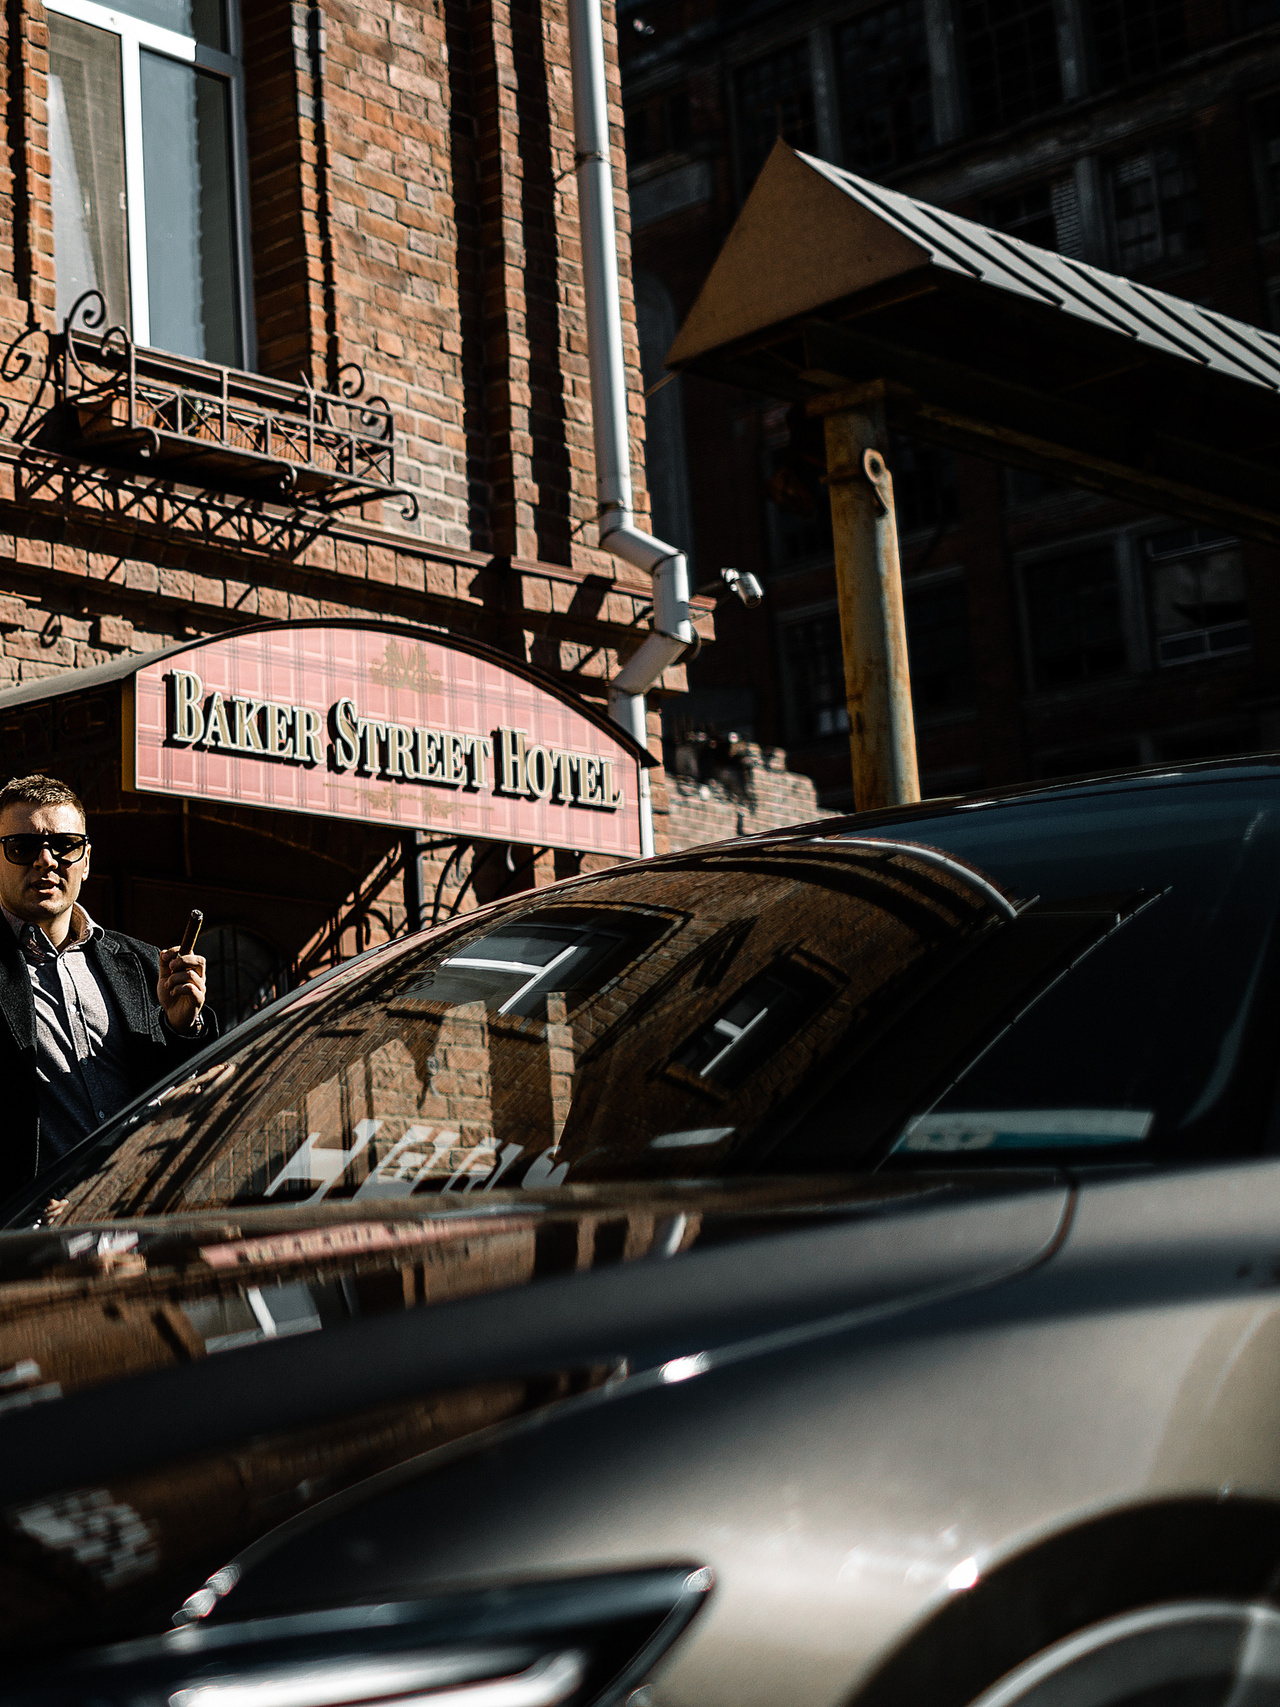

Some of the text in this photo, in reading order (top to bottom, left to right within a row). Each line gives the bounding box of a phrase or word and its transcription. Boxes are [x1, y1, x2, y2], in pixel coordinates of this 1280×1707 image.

[170, 668, 625, 809] BAKER STREET HOTEL
